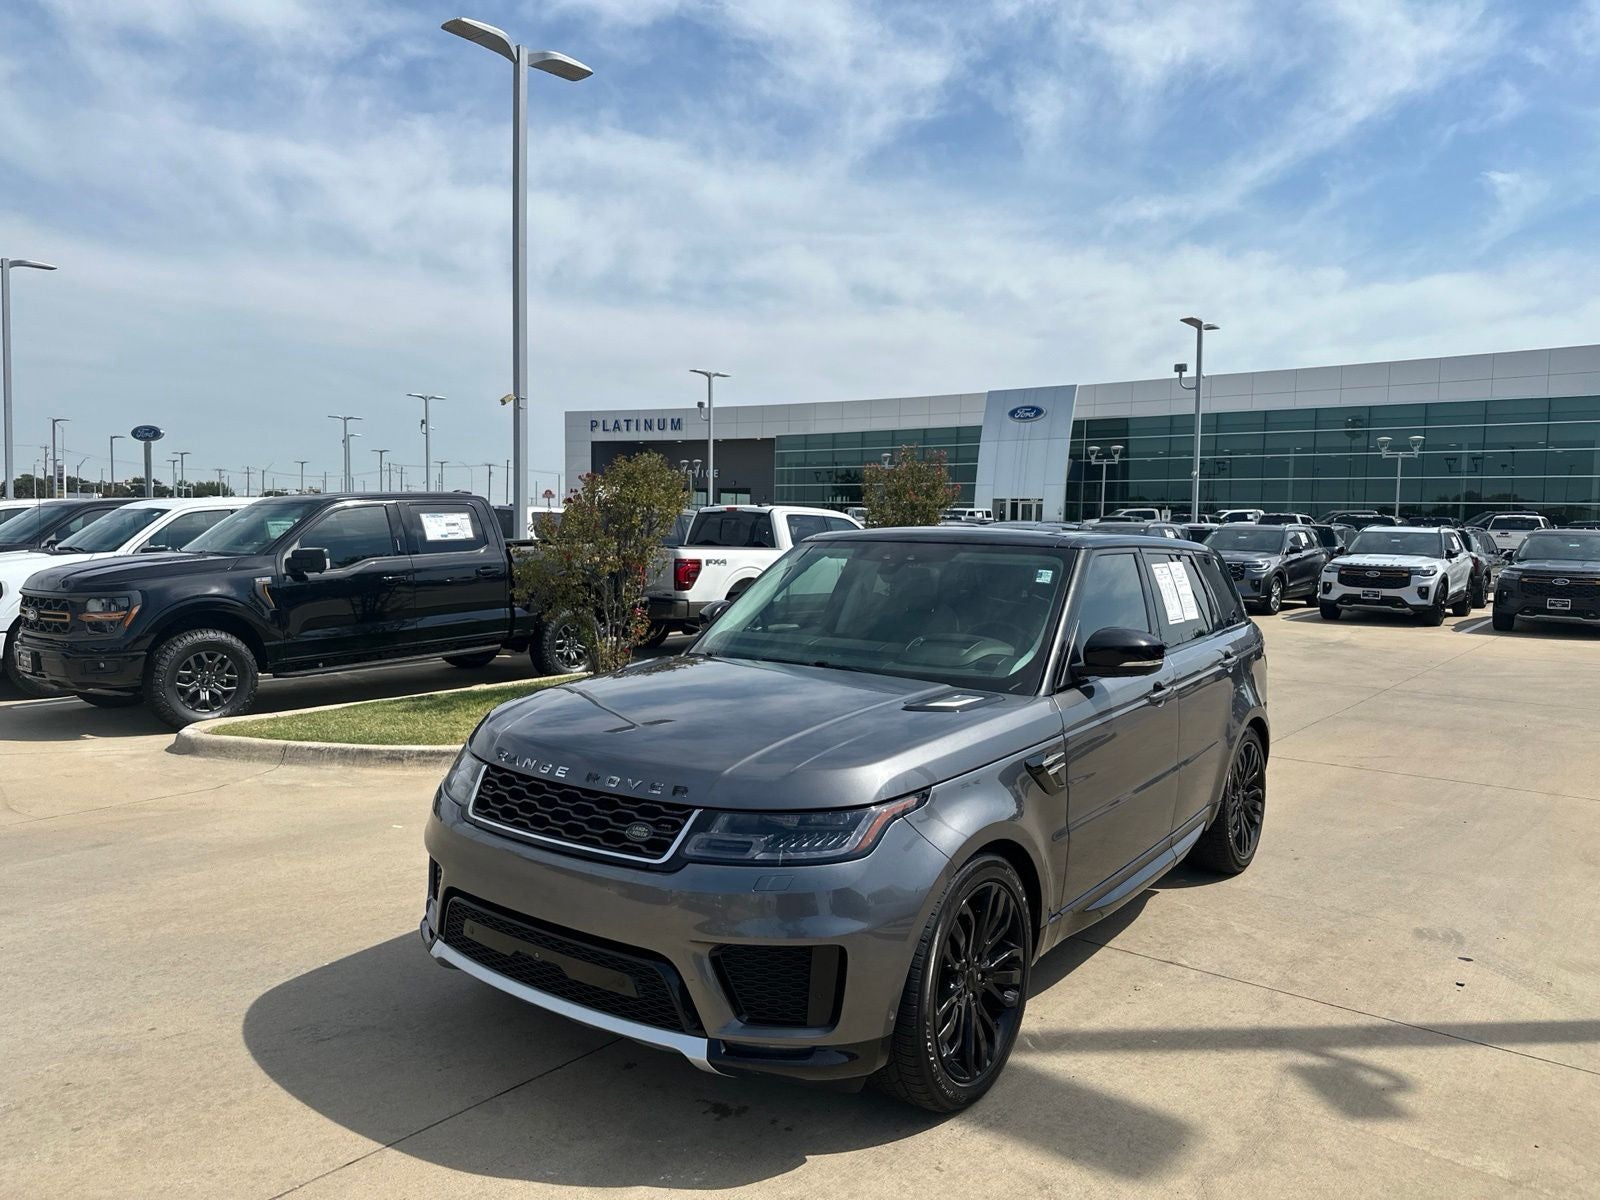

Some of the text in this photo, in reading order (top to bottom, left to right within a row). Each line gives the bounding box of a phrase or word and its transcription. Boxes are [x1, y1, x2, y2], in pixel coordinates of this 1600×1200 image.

[1014, 407, 1037, 418] Ford
[590, 418, 683, 432] PLATINUM
[705, 559, 727, 567] FX4
[497, 750, 689, 797] RANGE ROVER
